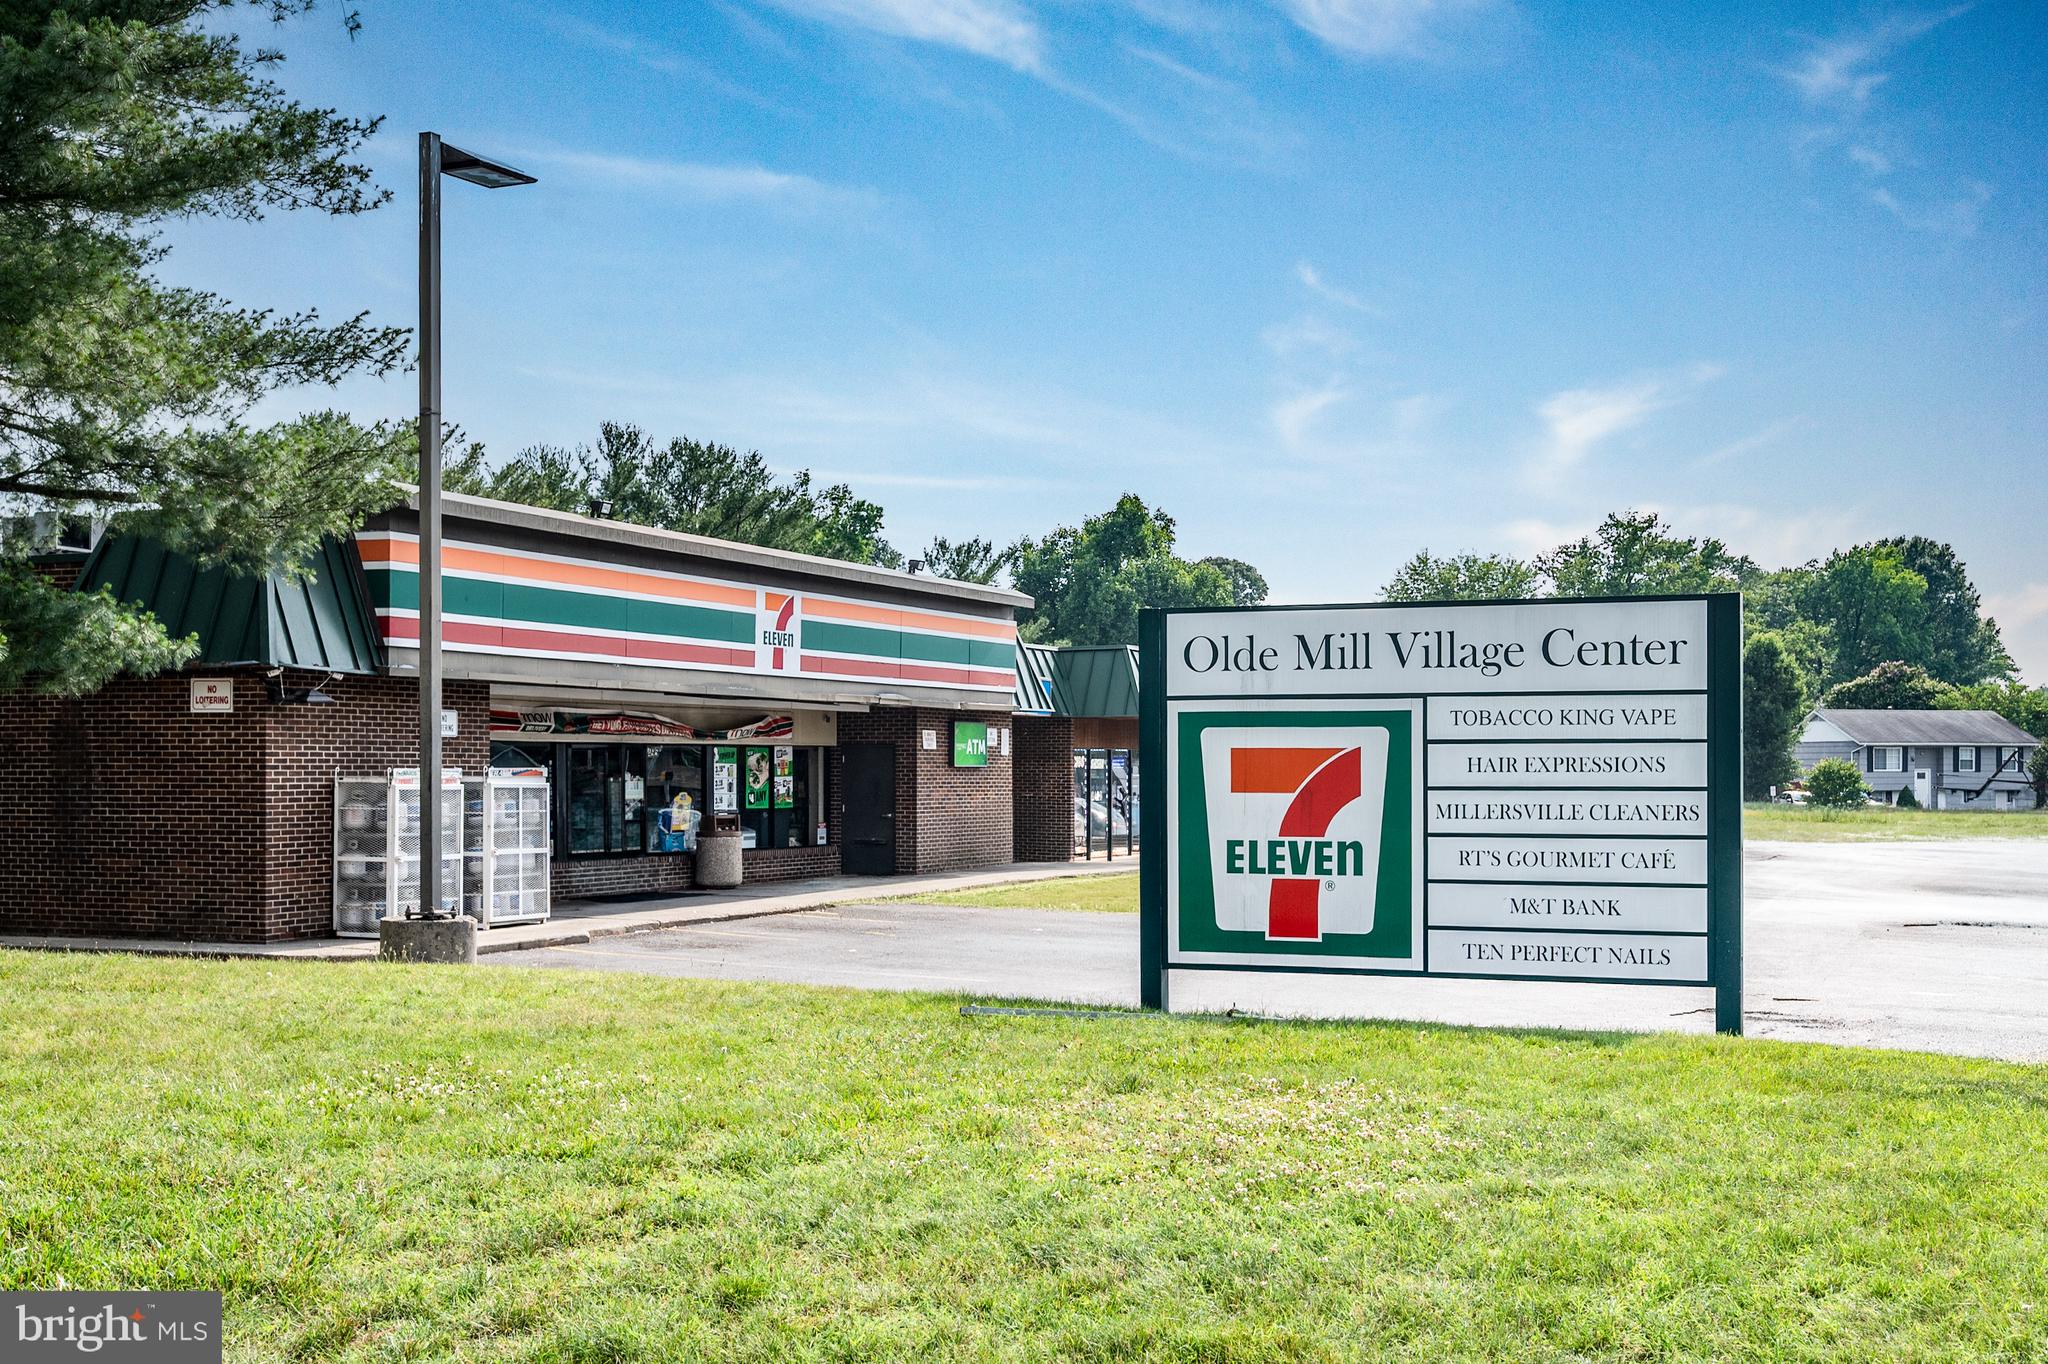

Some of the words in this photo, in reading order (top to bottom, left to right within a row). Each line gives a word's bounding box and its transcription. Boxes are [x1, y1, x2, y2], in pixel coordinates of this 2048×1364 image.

[1184, 634, 1279, 673] Olde
[1293, 632, 1373, 671] Mill
[1385, 630, 1525, 677] Village
[1541, 628, 1688, 668] Center
[207, 685, 217, 694] NO
[195, 696, 229, 704] LOITERING
[1450, 709, 1553, 727] TOBACCO
[1560, 709, 1615, 726] KING
[1621, 709, 1676, 726] VAPE
[966, 739, 986, 755] ATM
[1467, 756, 1518, 773] HAIR
[1526, 756, 1666, 774] EXPRESSIONS
[1436, 803, 1584, 821] MILLERSVILLE
[1590, 804, 1700, 822] CLEANERS
[1459, 850, 1501, 868] RT'S
[1507, 851, 1616, 869] GOURMET
[1621, 848, 1676, 869] CAFÉ
[1510, 898, 1557, 916] M&T
[1563, 899, 1622, 917] BANK
[1462, 943, 1504, 961] TEN
[1511, 945, 1603, 964] PERFECT
[1608, 947, 1671, 966] NAILS
